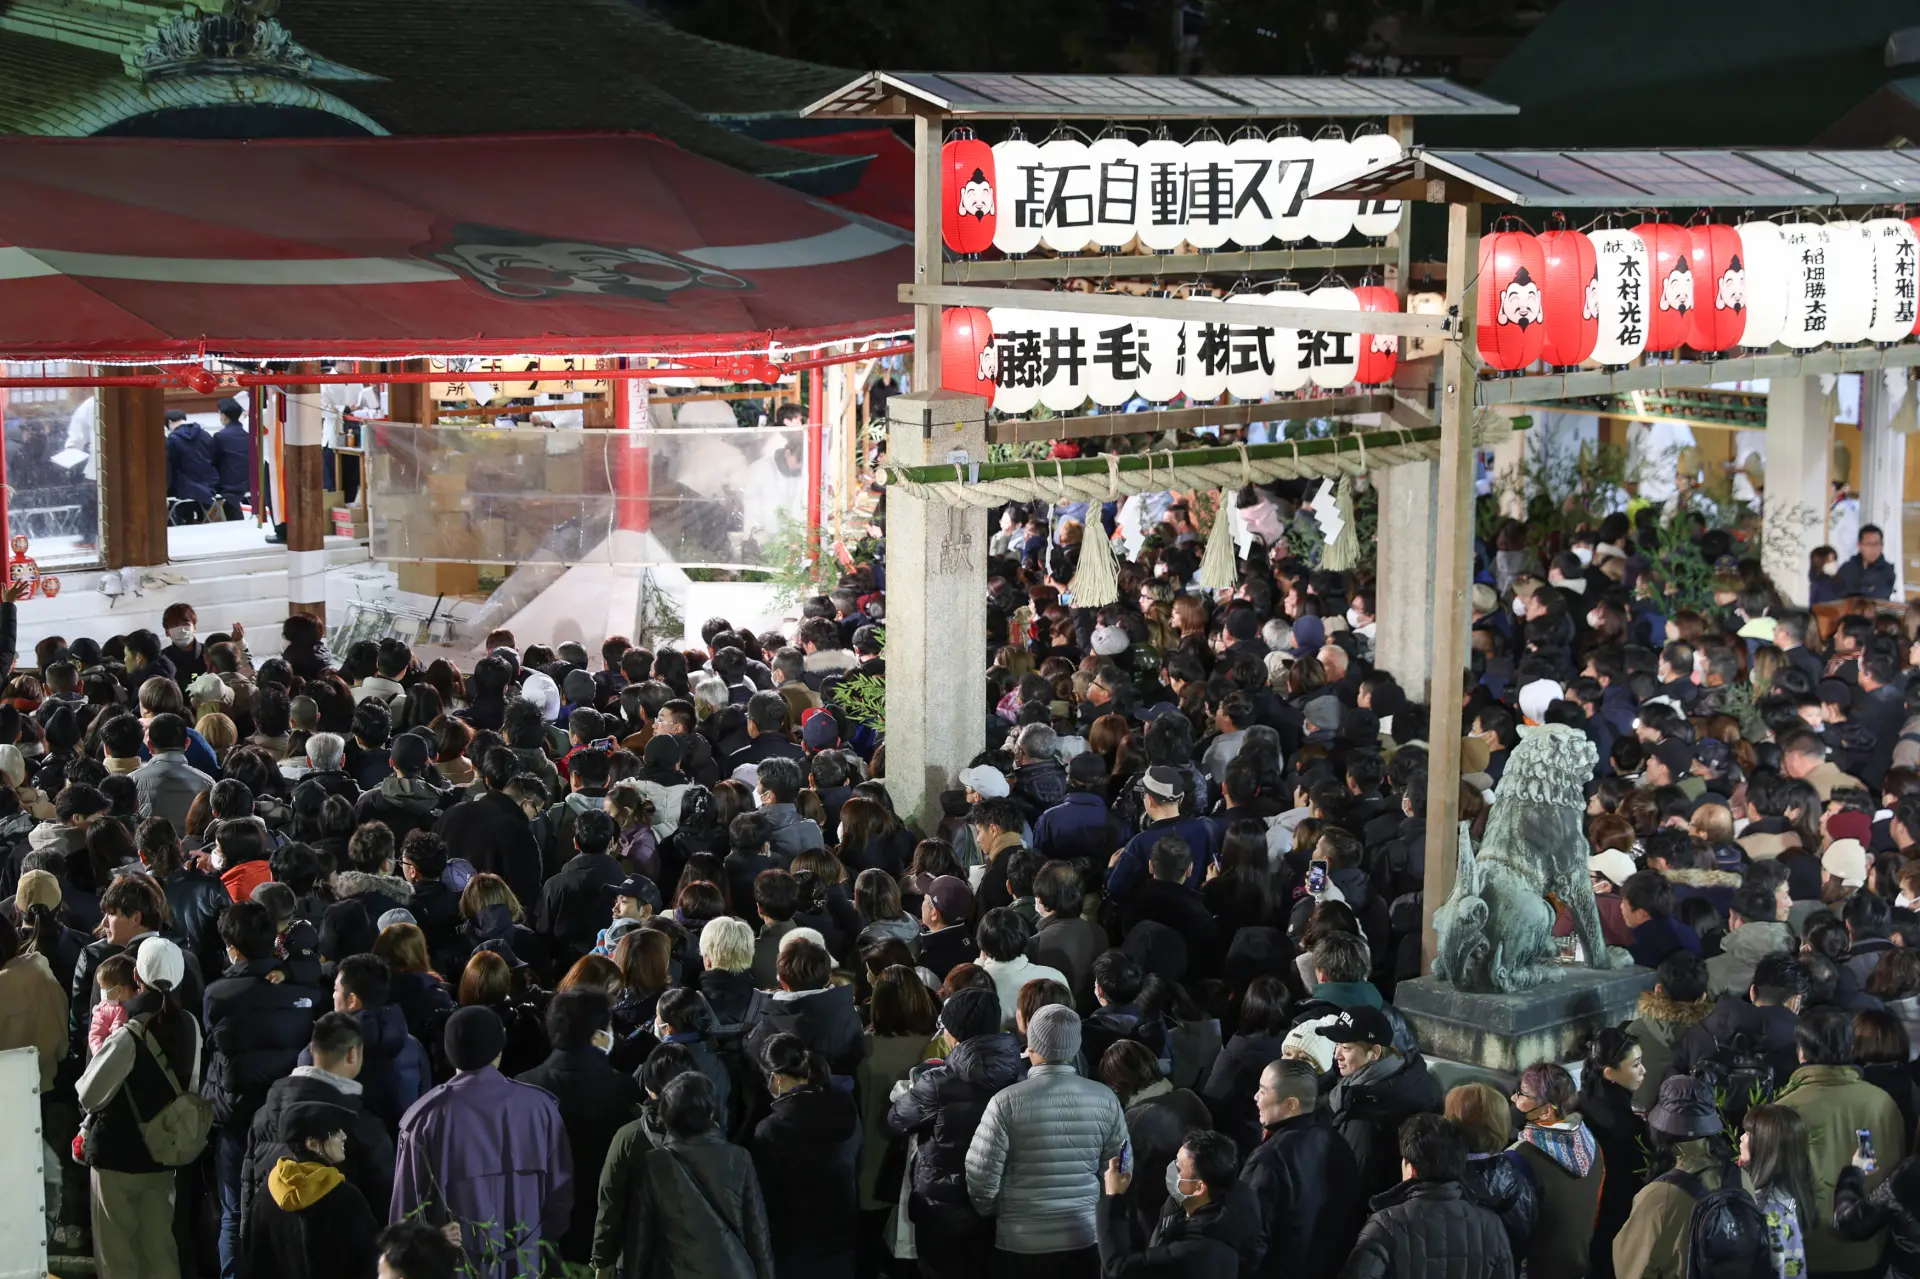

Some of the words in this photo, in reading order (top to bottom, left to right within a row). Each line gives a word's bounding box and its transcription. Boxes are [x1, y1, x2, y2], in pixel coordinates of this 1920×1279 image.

[1616, 254, 1642, 346] 木村光佑
[1894, 238, 1916, 322] 木村雅基
